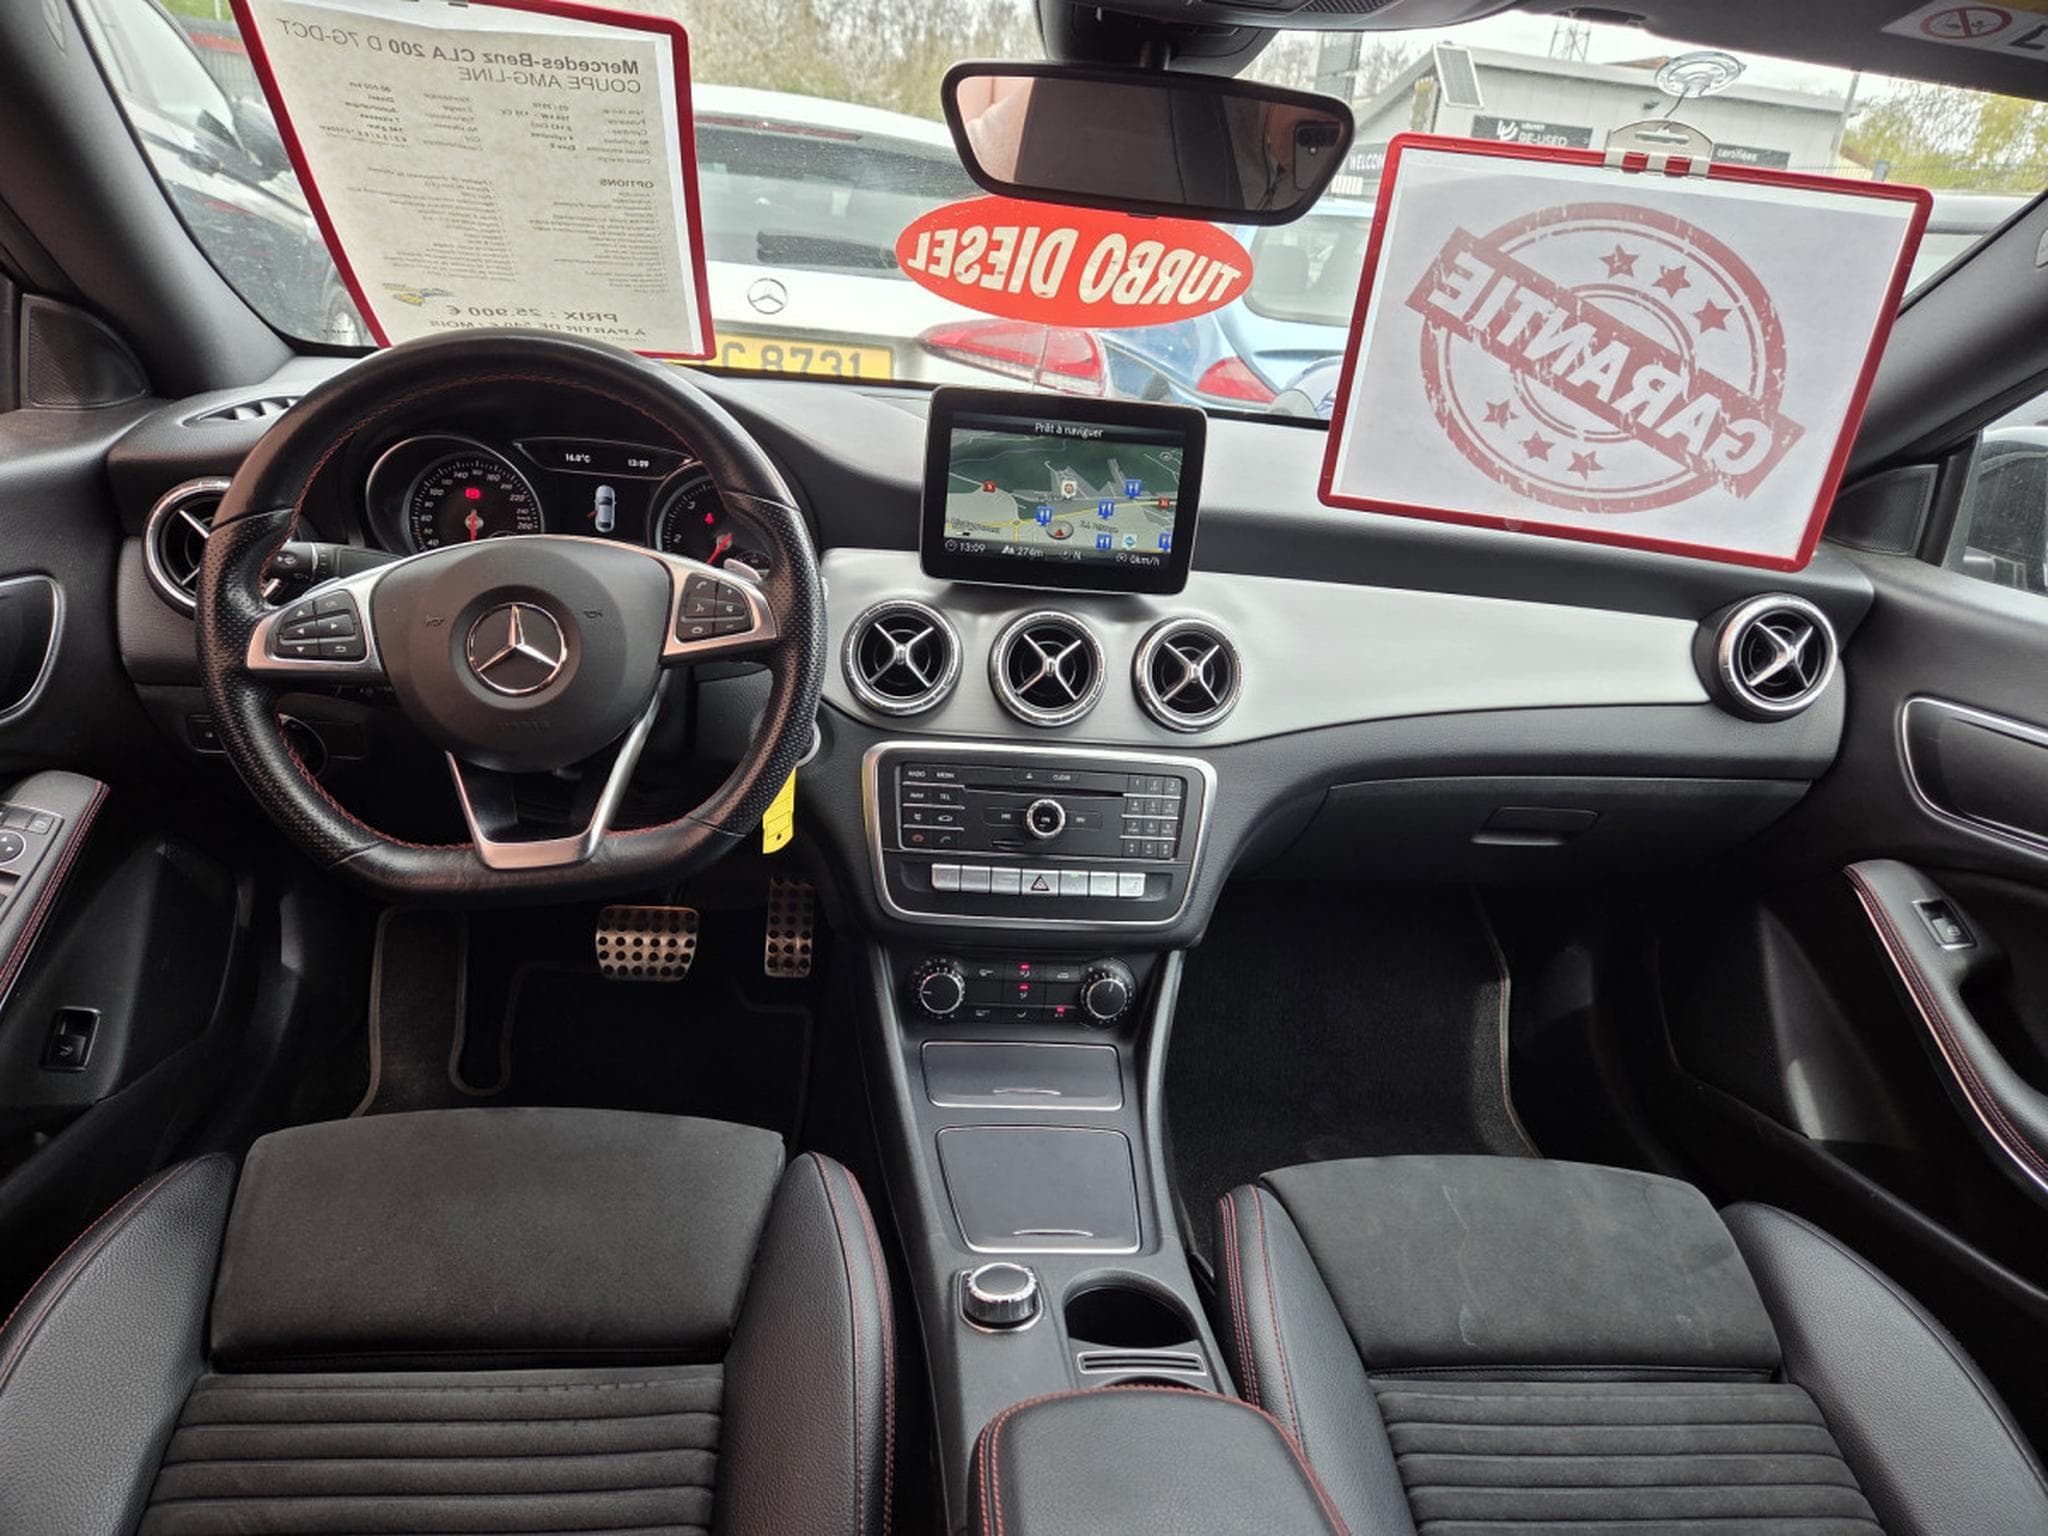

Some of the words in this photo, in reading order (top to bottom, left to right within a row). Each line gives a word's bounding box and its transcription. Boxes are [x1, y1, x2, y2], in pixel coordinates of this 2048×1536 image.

[1034, 421, 1055, 433] Prêt
[1064, 426, 1104, 439] naviguer
[959, 542, 986, 553] 13:09
